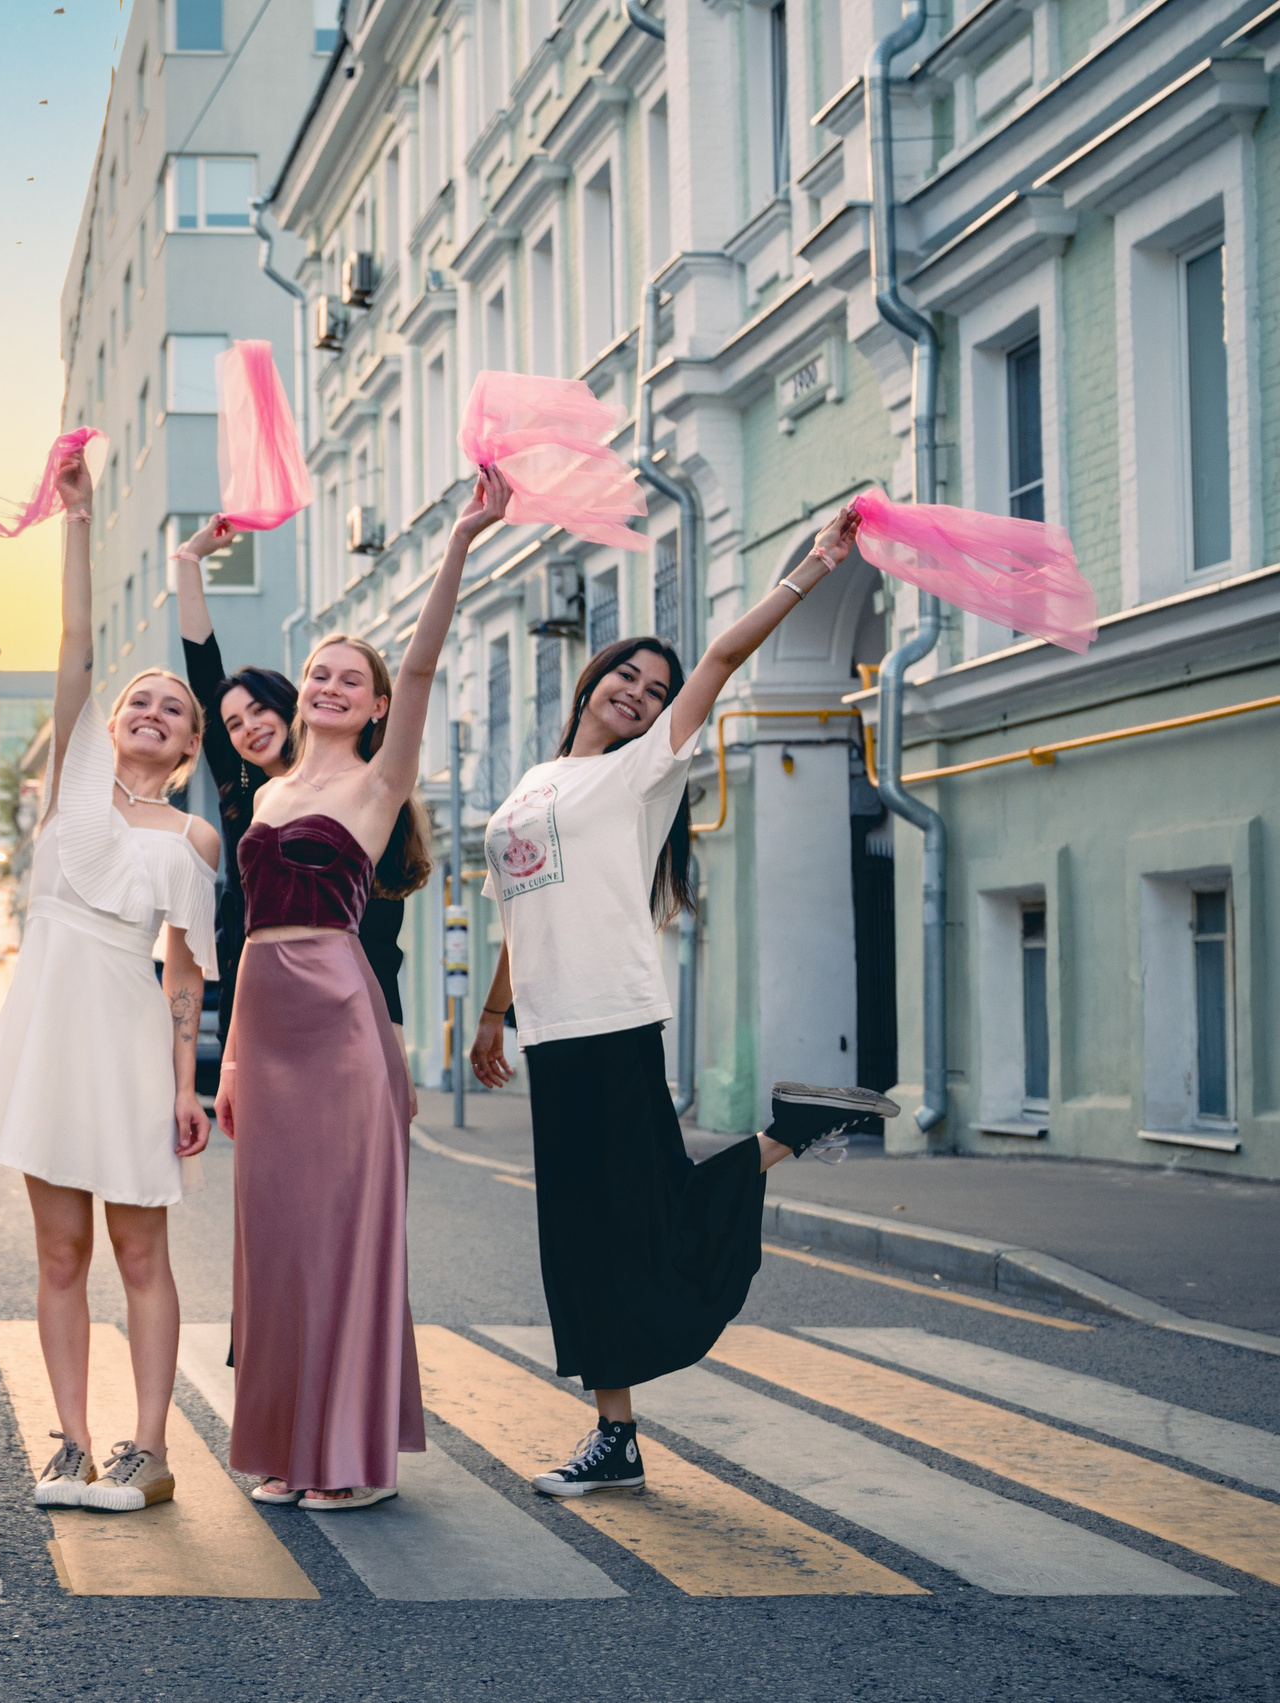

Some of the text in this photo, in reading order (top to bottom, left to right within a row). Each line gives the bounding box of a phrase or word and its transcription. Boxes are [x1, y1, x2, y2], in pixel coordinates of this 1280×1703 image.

[548, 825, 556, 847] PASTA
[502, 872, 560, 898] TALIAN CUISINE
